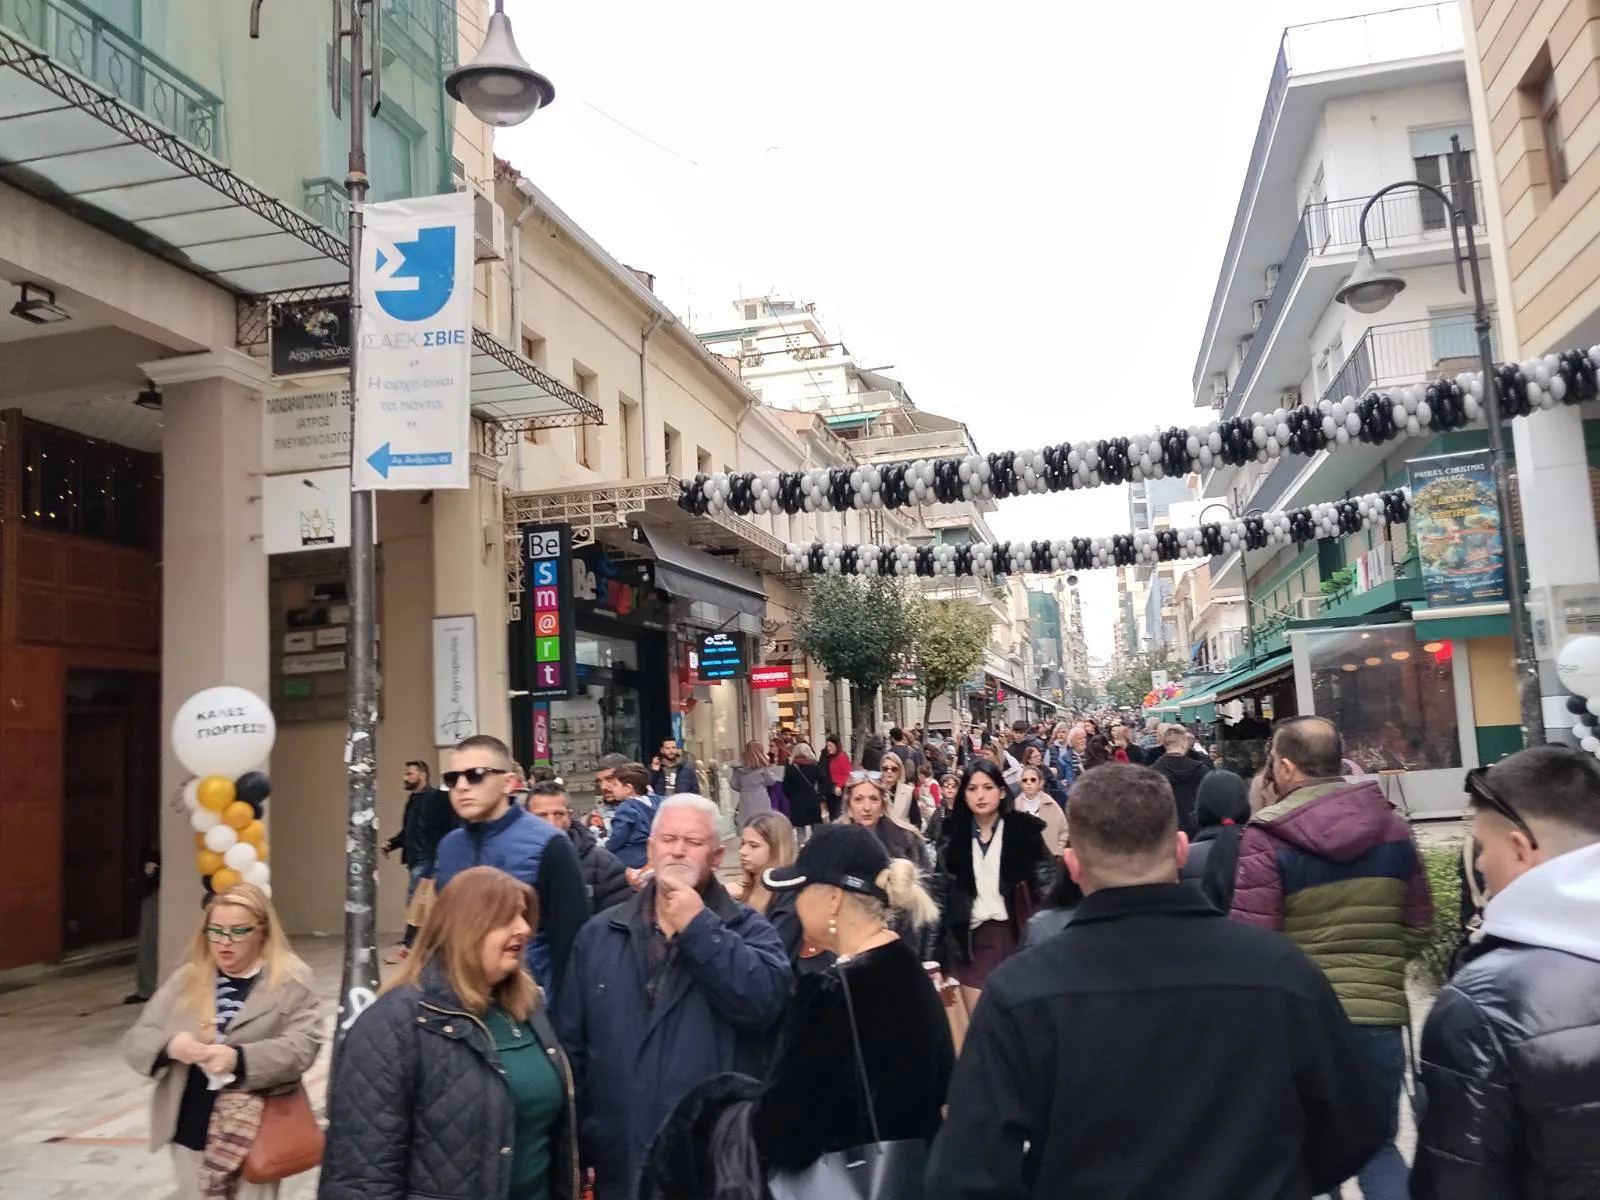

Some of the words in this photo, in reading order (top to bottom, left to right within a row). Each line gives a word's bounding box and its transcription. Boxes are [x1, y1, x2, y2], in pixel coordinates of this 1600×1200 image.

[423, 329, 465, 346] ΣΒΙΕ
[531, 535, 558, 556] Be
[196, 707, 246, 721] ΚΑΛΕΣ
